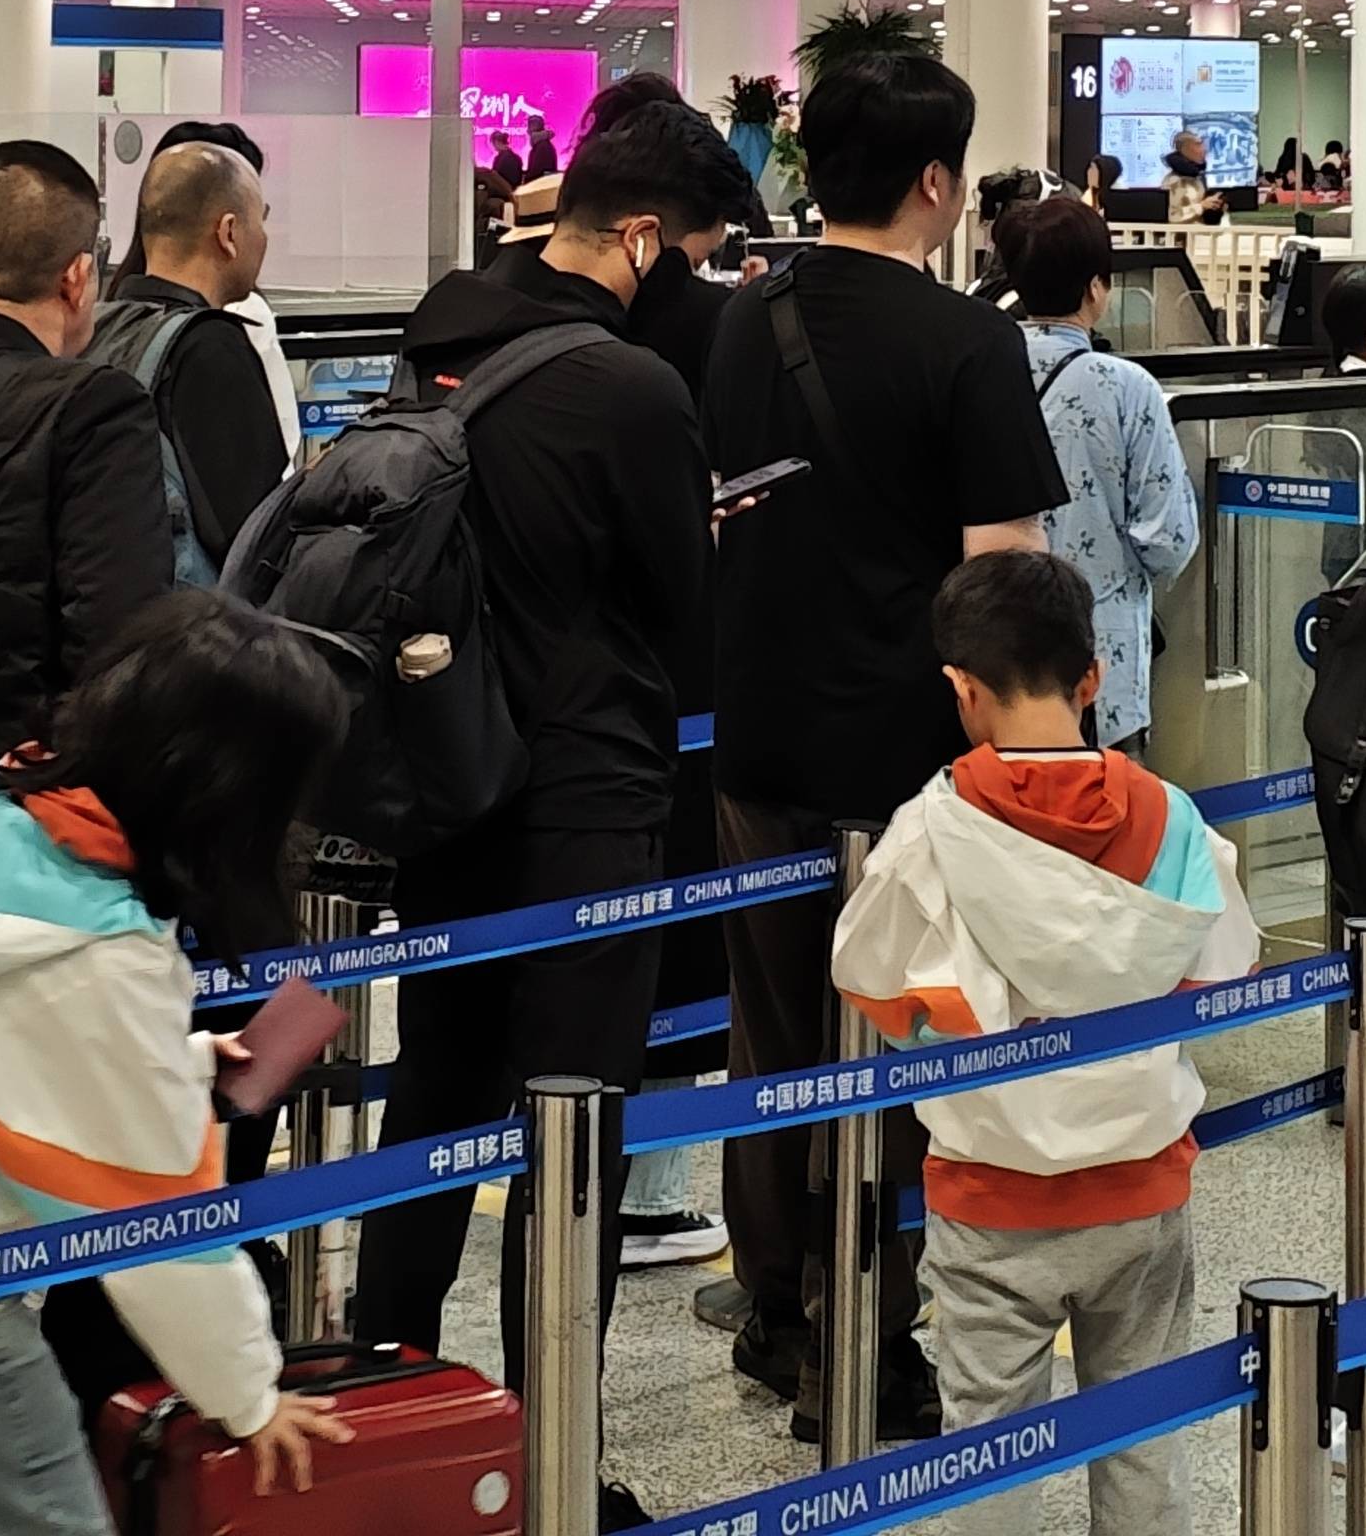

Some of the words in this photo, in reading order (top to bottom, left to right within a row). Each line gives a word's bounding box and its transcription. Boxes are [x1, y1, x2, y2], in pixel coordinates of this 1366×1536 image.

[1071, 66, 1097, 98] 16
[576, 888, 673, 930] 中国移民管理
[684, 875, 733, 905] CHINA
[737, 856, 836, 895] IMMIGRATION
[329, 933, 450, 974] IMMIGRATION
[756, 1068, 874, 1115] 中国移民管理
[888, 1057, 946, 1090] CHINA
[952, 1030, 1072, 1077] IMMIGRATION
[1196, 972, 1291, 1021] 中国移民管理
[1302, 963, 1350, 993] CHINA
[428, 1126, 524, 1176] 中国移民
[61, 1198, 241, 1261] IMMIGRATION
[1240, 1345, 1261, 1387] 中
[781, 1482, 868, 1536] CHINA
[877, 1418, 1057, 1507] IMMIGRATION
